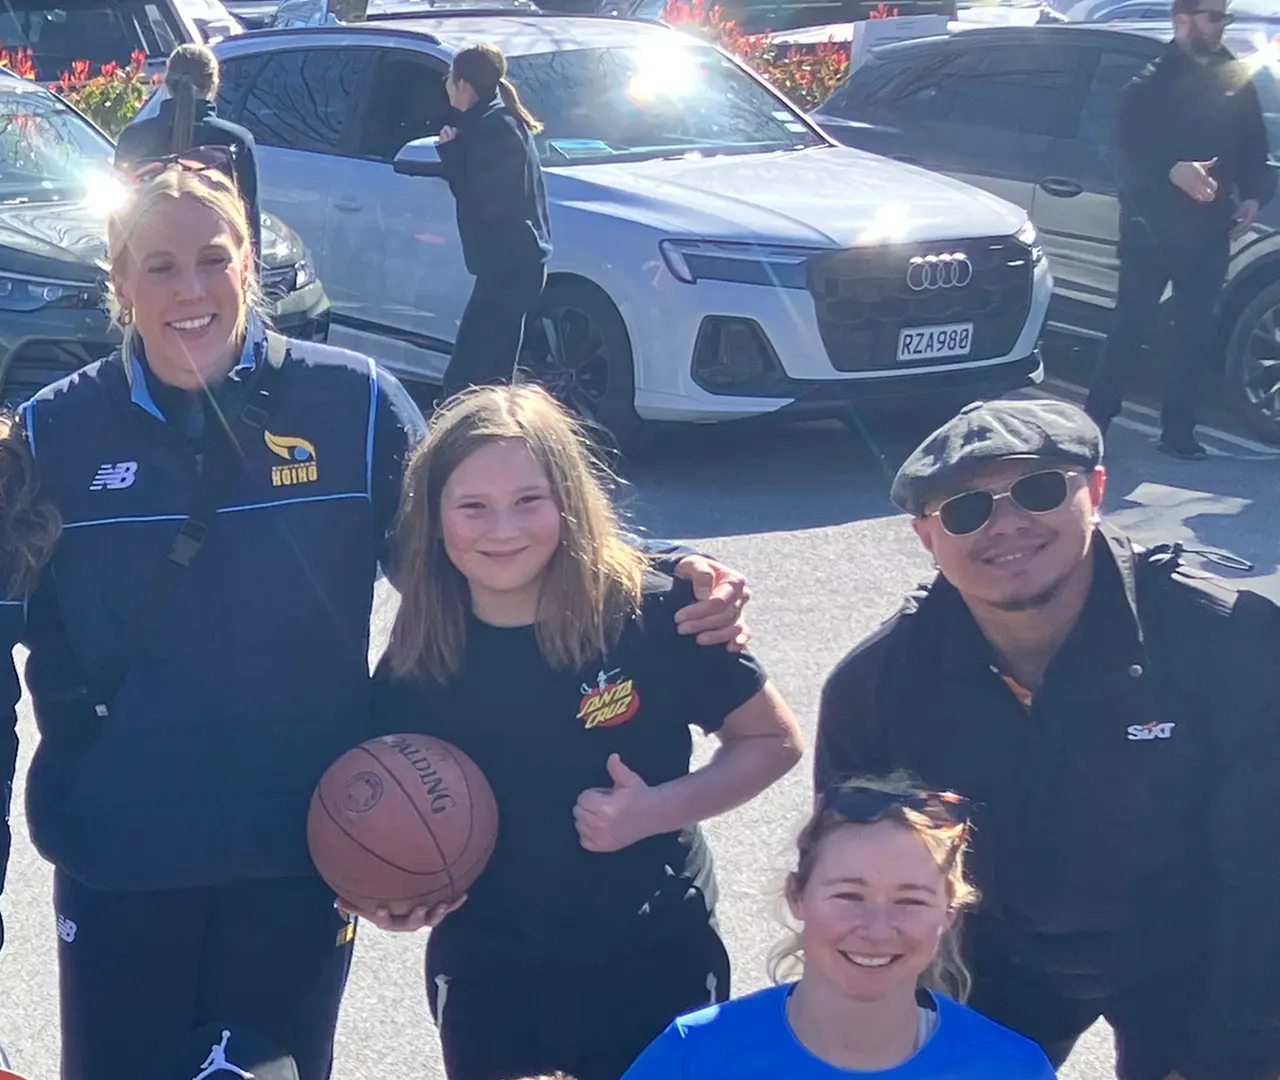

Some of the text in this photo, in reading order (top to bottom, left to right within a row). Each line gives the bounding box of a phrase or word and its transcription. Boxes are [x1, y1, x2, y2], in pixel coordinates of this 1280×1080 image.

[901, 328, 969, 355] RZA980
[89, 461, 138, 491] NB
[271, 466, 318, 486] HOIHO
[575, 679, 633, 719] SANTA
[584, 695, 633, 729] CRUZ
[1127, 720, 1176, 740] SIXT
[385, 734, 456, 815] PALDING
